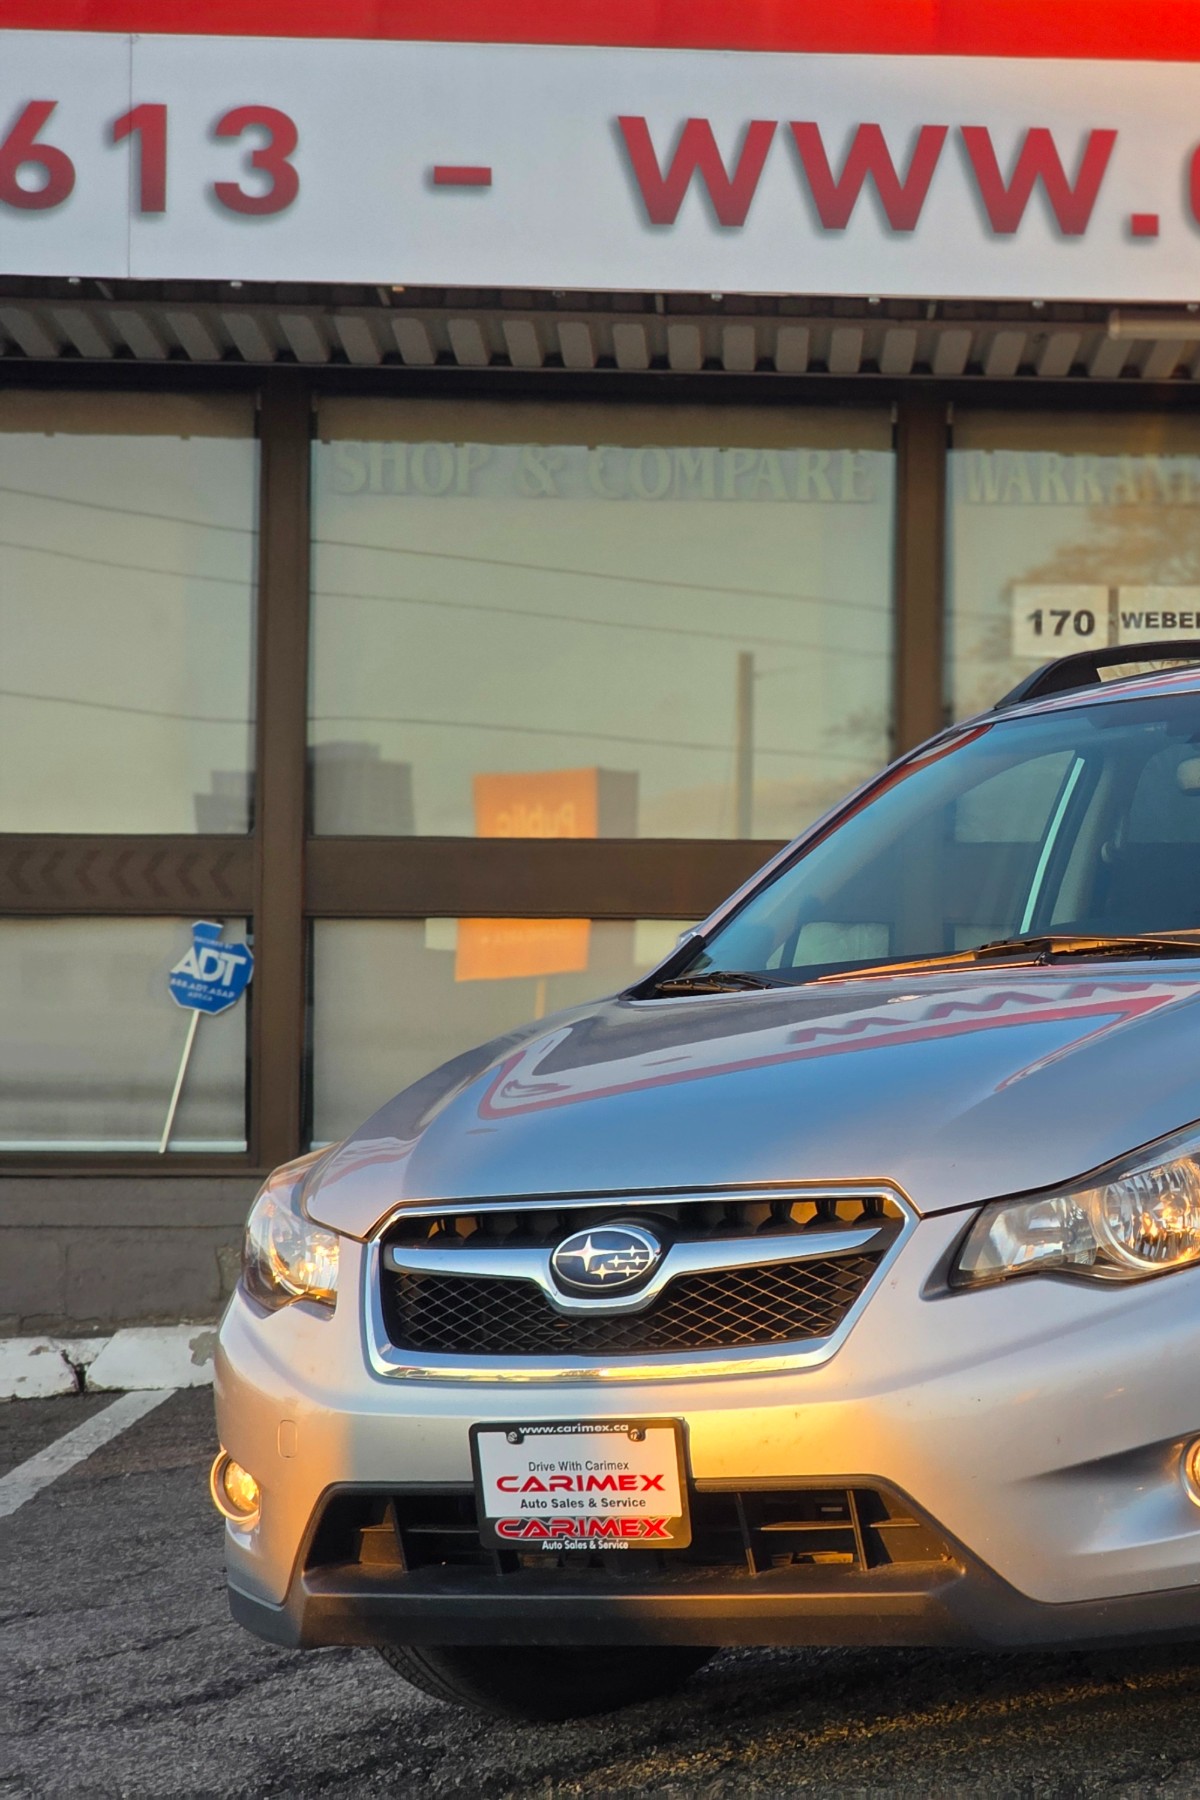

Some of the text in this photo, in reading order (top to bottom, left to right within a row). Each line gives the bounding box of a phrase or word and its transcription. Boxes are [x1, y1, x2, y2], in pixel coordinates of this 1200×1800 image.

[0, 100, 300, 215] 613
[333, 441, 875, 503] SHOP & COMPARE
[1027, 609, 1095, 636] 170
[170, 946, 247, 986] ADT
[519, 1423, 629, 1434] www.carimex.ca
[528, 1460, 629, 1472] Drive With Carimex
[496, 1474, 665, 1492] CARIMEX
[520, 1497, 646, 1509] Auto Sales & Service
[496, 1518, 672, 1538] CARIMEX
[542, 1539, 629, 1550] Auto Sales & Service
